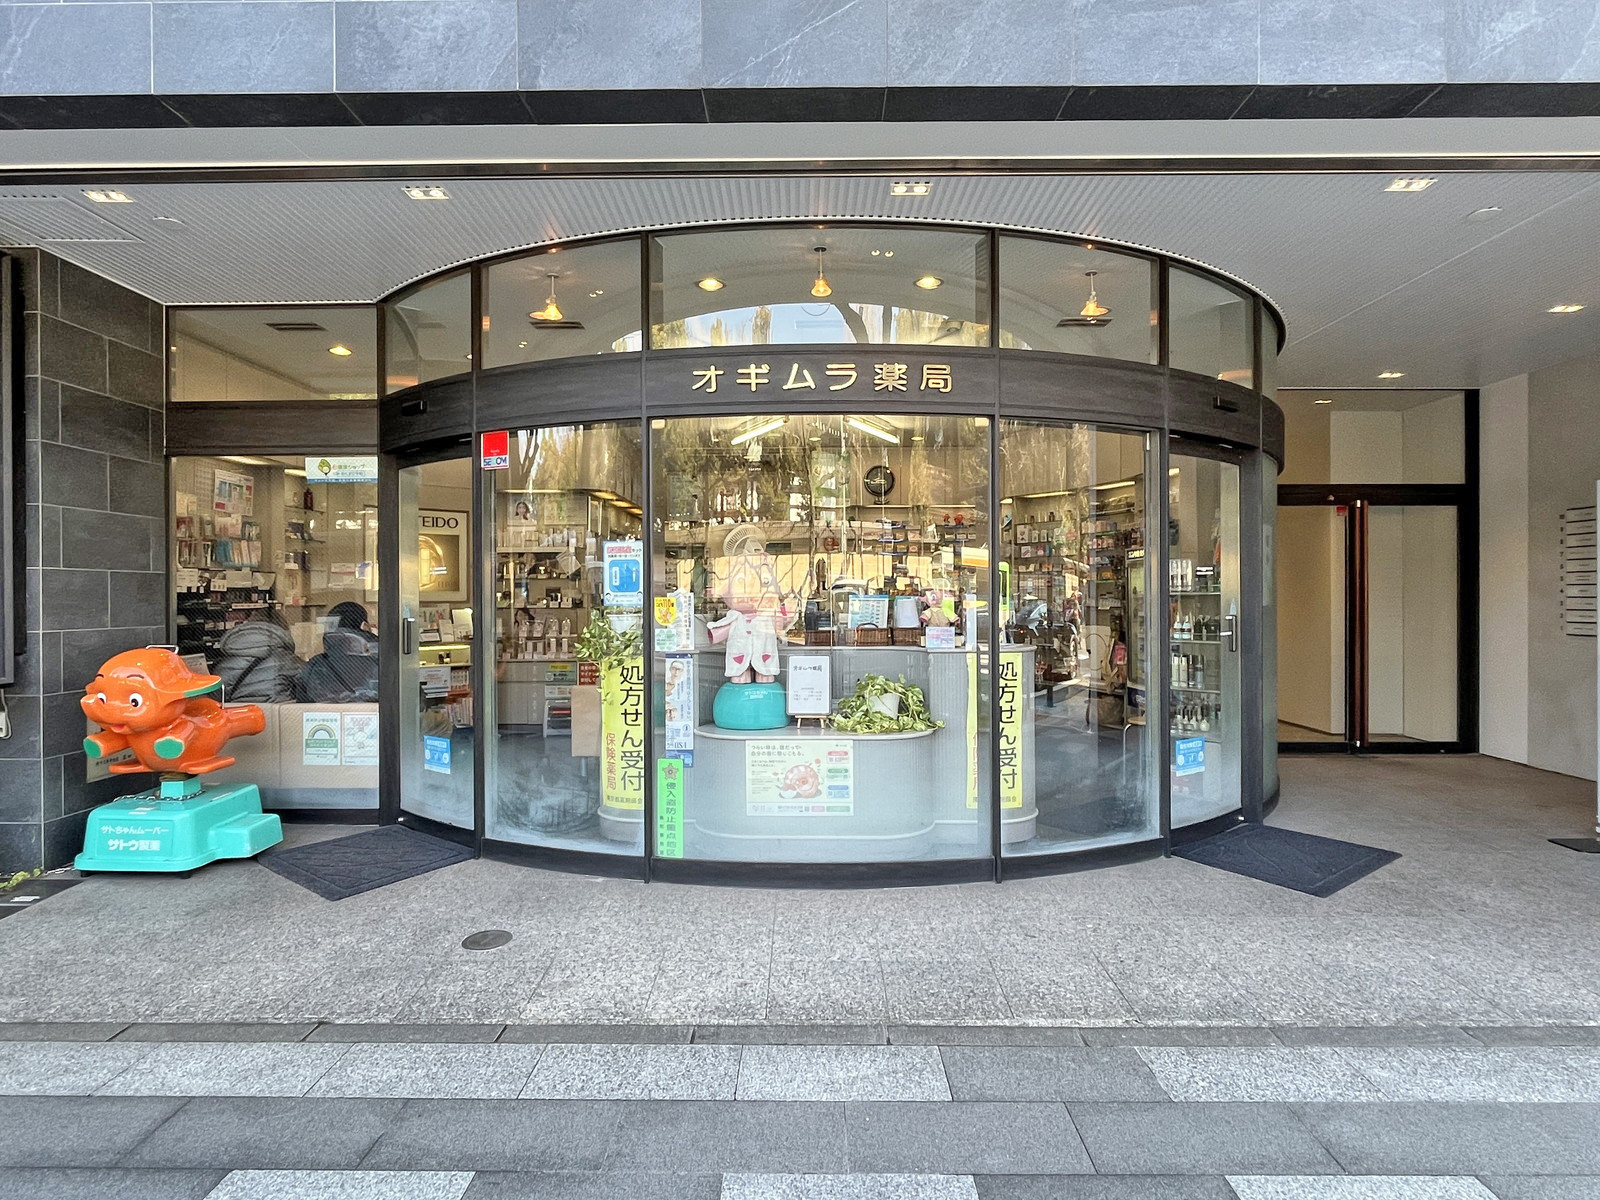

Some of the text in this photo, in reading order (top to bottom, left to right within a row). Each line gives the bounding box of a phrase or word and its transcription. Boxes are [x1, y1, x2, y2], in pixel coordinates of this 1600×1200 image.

[691, 362, 953, 393] オギムラ薬局
[483, 456, 507, 467] SEOM
[419, 515, 459, 529] EIDO
[619, 665, 644, 792] 処方せん受付
[101, 825, 169, 834] サトちゃんムーバー
